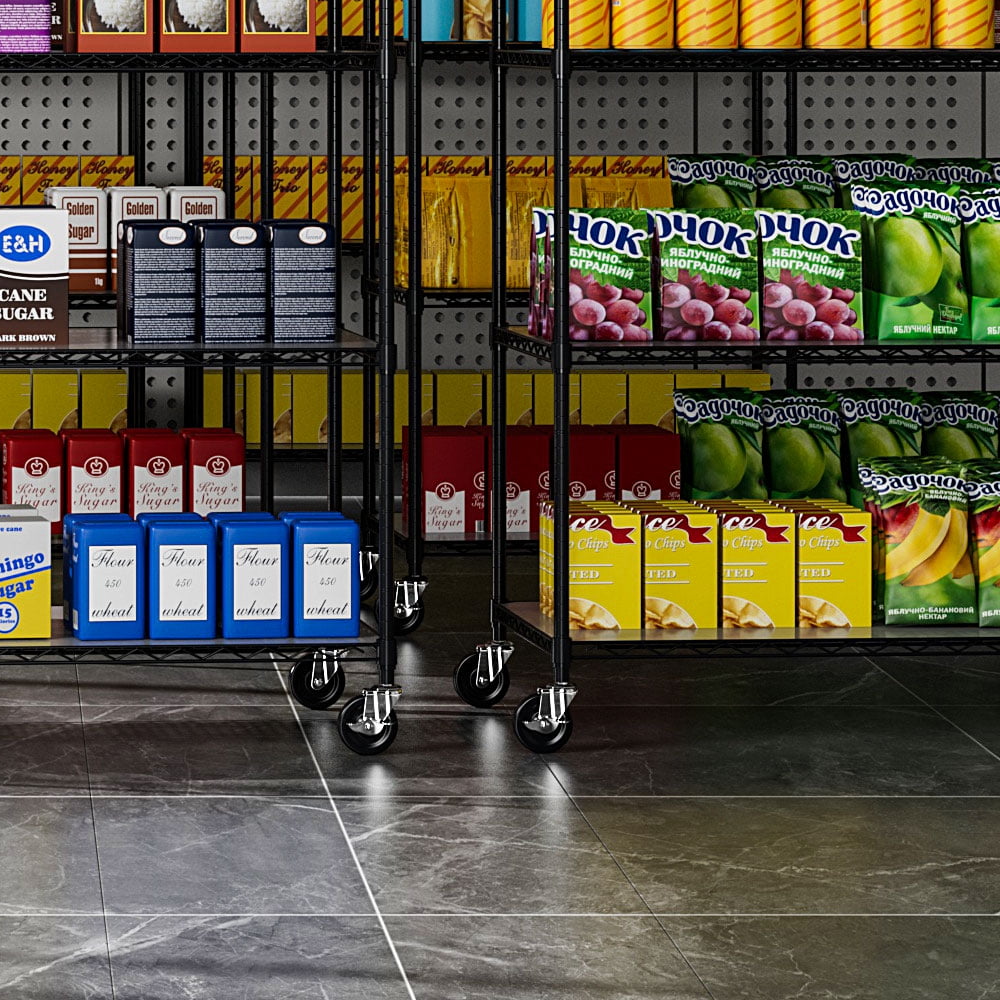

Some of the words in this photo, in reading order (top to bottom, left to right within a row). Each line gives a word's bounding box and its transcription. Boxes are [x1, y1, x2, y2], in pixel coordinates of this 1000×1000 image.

[27, 160, 79, 175] Honey
[86, 160, 135, 180] Honey
[433, 159, 485, 176] Honey
[611, 158, 663, 176] Honey
[127, 202, 154, 215] Golden
[185, 202, 213, 215] Golden
[2, 235, 43, 253] E&H
[670, 248, 730, 265] ЯБЛУЧНО-
[772, 248, 833, 265] ЯБЛУЧНО-
[894, 324, 931, 333] ЯБЛУЧНИЙ
[933, 325, 957, 334] НЕКТАР
[19, 334, 56, 342] BROWN
[14, 495, 57, 507] Sugar
[74, 495, 117, 510] Sugar
[136, 495, 180, 509] Sugar
[195, 494, 239, 509] Sugar
[426, 517, 462, 530] Sugar
[578, 538, 609, 552] Chips
[654, 538, 685, 552] Chips
[732, 537, 763, 551] Chips
[808, 536, 840, 551] Chips
[91, 549, 134, 569] Flour
[162, 548, 205, 568] Flour
[236, 548, 278, 567] Flour
[306, 547, 349, 567] Flour
[92, 602, 133, 617] wheat
[163, 601, 204, 617] wheat
[237, 601, 277, 616] wheat
[307, 600, 348, 616] wheat
[888, 606, 974, 616] ЯБЛУЧНО-БАНАНОВИЙ
